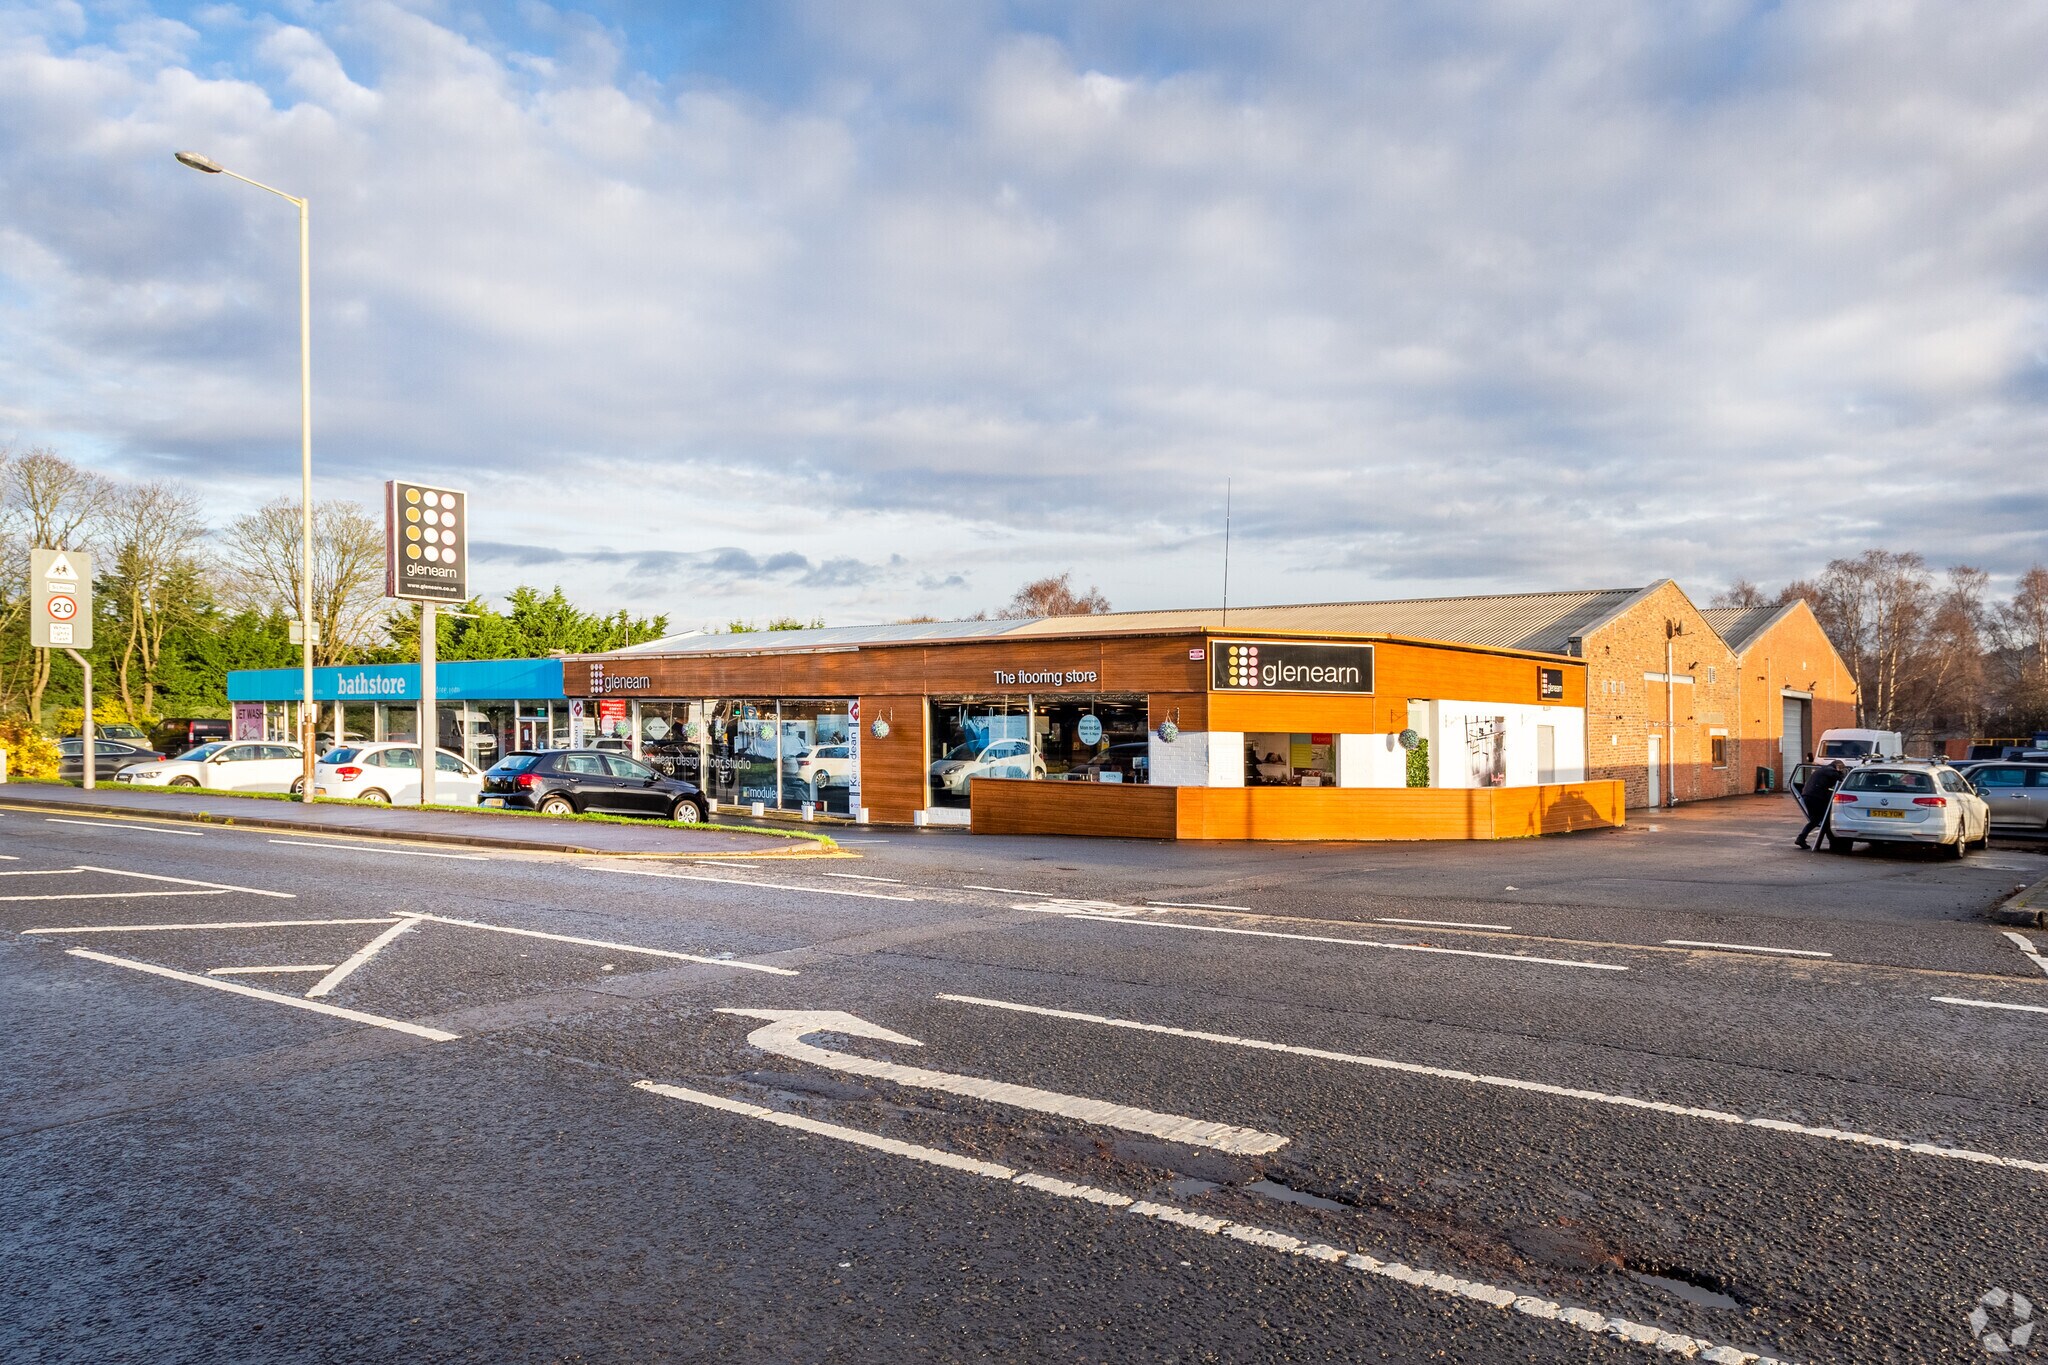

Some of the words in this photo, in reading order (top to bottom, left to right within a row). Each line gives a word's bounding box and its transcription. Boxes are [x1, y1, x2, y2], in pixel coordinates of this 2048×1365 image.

[407, 563, 457, 578] glenearn
[407, 583, 457, 592] www.glenearn.co.uk
[53, 602, 73, 613] 20
[993, 670, 1016, 684] The
[1018, 668, 1063, 686] flooring
[1065, 669, 1097, 682] store
[1262, 660, 1359, 686] glenearn
[338, 672, 406, 695] bathstore
[605, 673, 650, 693] glenearn
[1547, 683, 1562, 694] glenearn
[247, 709, 263, 719] WASH
[725, 757, 751, 770] studio
